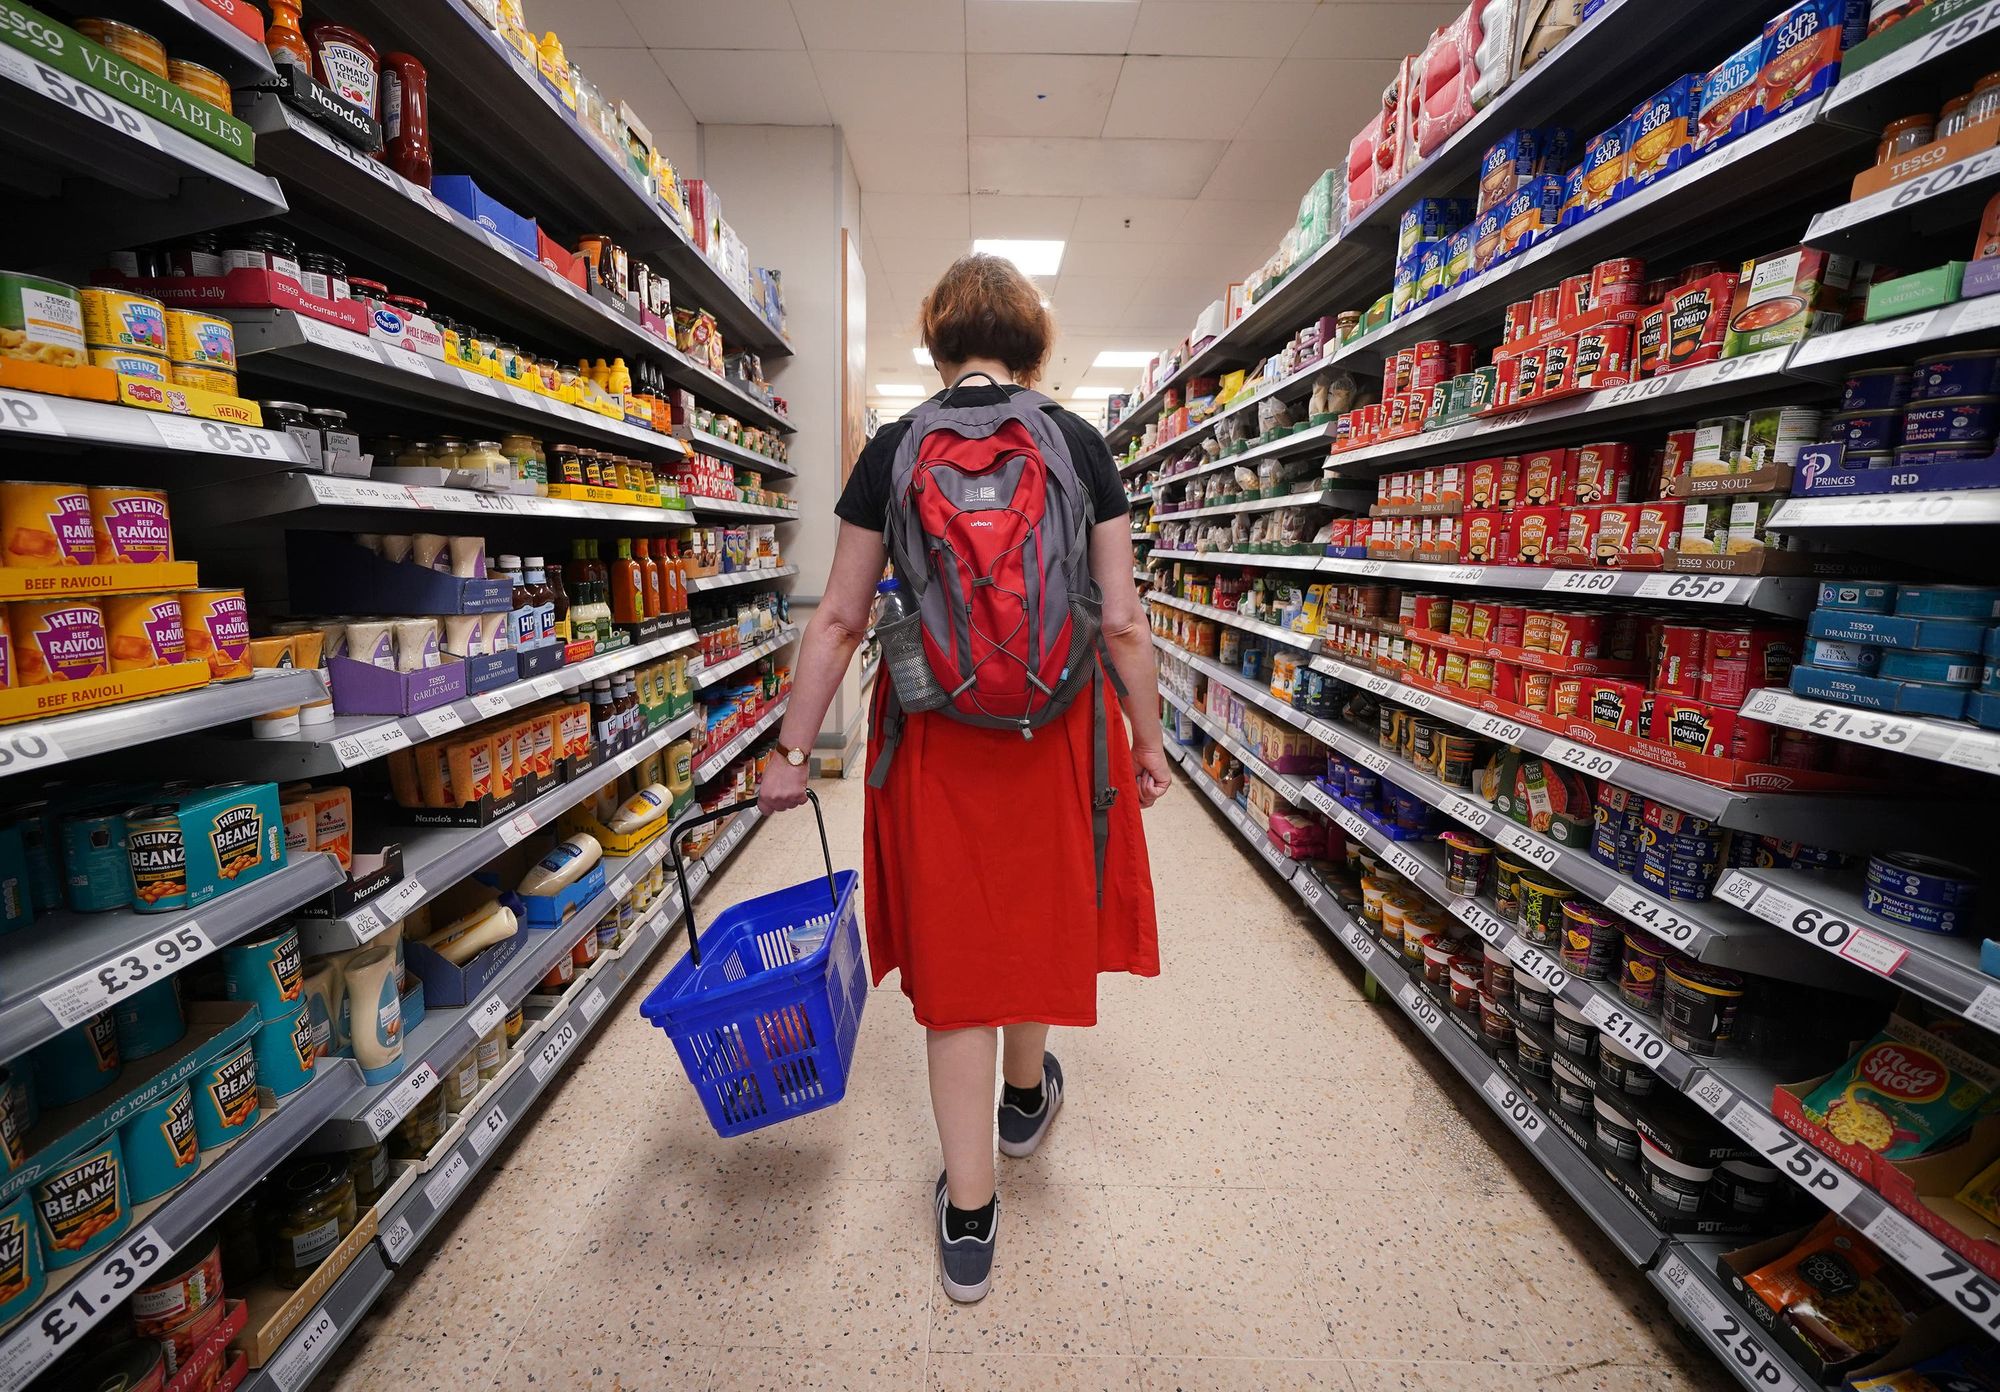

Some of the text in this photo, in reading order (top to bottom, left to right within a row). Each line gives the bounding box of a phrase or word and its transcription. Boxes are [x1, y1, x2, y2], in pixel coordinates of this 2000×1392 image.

[1776, 20, 1818, 54] SOUP
[334, 48, 367, 69] HEINZ
[333, 60, 370, 82] TOMATO
[337, 71, 369, 88] KETCHUP
[1713, 70, 1749, 100] SOUP
[33, 63, 142, 134] 50p
[79, 45, 243, 147] VEGETABLES
[310, 82, 371, 135] Nando's
[1642, 111, 1670, 135] SOUP
[1595, 143, 1621, 165] SOUP
[1891, 147, 1947, 175] TESCO
[1891, 155, 1995, 208] 60p
[1767, 258, 1788, 270] TESCO
[1755, 273, 1764, 286] 5
[200, 287, 226, 299] Jelly
[277, 282, 299, 296] TESCO
[1678, 292, 1706, 310] HEINZ
[133, 306, 161, 319] HEINZ
[340, 310, 356, 324] Jelly
[1673, 310, 1708, 329] TOMATO
[206, 326, 231, 339] HEINZ
[405, 325, 420, 339] WHOLE
[1887, 319, 1925, 338] 55p
[121, 361, 157, 374] HEINZ
[128, 384, 163, 402] Peppa Pig
[1609, 376, 1668, 405] £1.10
[217, 407, 250, 422] HEINZ
[1908, 410, 1945, 421] PRINCES
[1907, 423, 1919, 431] RED
[200, 422, 271, 455] 85p
[1905, 432, 1936, 441] SALMON
[1692, 477, 1752, 491] TESCO SOUP
[1815, 474, 1919, 486] PRINCES RED
[355, 488, 379, 497] £1.70
[119, 500, 164, 516] HEINZ
[117, 526, 168, 539] RAVIOLI
[1362, 562, 1381, 574] 65p
[1678, 558, 1735, 571] TESCO SOUP
[25, 575, 113, 590] BEEF RAVIOLI
[1564, 574, 1615, 590] £1.60
[1667, 575, 1726, 601] 65p
[50, 610, 100, 628] HEINZ
[521, 615, 536, 632] HP
[543, 611, 555, 628] HP
[1850, 622, 1874, 631] TESCO
[72, 631, 90, 639] BEEF
[1825, 629, 1897, 645] DRAINED TUNA
[50, 637, 105, 655] RAVIOLI
[1825, 648, 1848, 656] TUNA
[488, 660, 503, 669] TESCO
[1821, 653, 1851, 662] STEAKS
[428, 674, 446, 685] TESCO
[1367, 678, 1388, 691] 65p
[1832, 681, 1856, 692] TESCO
[37, 684, 124, 709] BEEF RAVIOLI
[413, 680, 460, 702] GARLIC SAUCE
[1403, 689, 1431, 706] £1.60
[1599, 692, 1620, 704] HEINZ
[1807, 686, 1881, 706] DRAINED TUNA
[489, 696, 505, 706] 95p
[440, 711, 456, 722] £1.35
[1594, 705, 1619, 719] TOMATO
[1678, 711, 1705, 726] HEINZ
[1481, 717, 1521, 741] £1.60
[1571, 727, 1594, 741] HEINZ
[1673, 726, 1706, 742] TOMATO
[1809, 707, 1907, 745] £1.35
[382, 729, 403, 742] £1.25
[1319, 729, 1338, 744] £1.35
[340, 745, 360, 757] 02D
[1629, 746, 1687, 769] FAVOURITE RECIPES
[1637, 741, 1677, 759] THE NATION'S
[575, 762, 592, 775] Nando's
[1364, 754, 1389, 772] £1.35
[1561, 748, 1613, 775] £2.80
[1528, 771, 1542, 780] WEST
[1751, 776, 1789, 789] HEINZ
[536, 780, 556, 794] Nando's
[492, 801, 516, 817] Nando's
[1313, 792, 1333, 811] £1.05
[219, 808, 252, 829] HEINZ
[415, 814, 452, 823] Nando's
[1452, 801, 1486, 827] £2.80
[216, 821, 259, 848] BEANZ
[1344, 816, 1367, 837] £1.05
[134, 832, 178, 847] HEINZ
[131, 847, 186, 867] BEANZ
[1511, 834, 1556, 864] £2.80
[1391, 852, 1420, 876] £1.10
[353, 874, 390, 902] Nando's
[400, 881, 418, 899] £2.10
[1302, 881, 1319, 900] 90p
[1728, 884, 1750, 899] 01C
[1883, 895, 1914, 911] PRINCES
[355, 913, 368, 923] 12L
[1461, 905, 1500, 938] £1.10
[1629, 900, 1692, 942] £4.20
[1882, 903, 1937, 923] TUNA CHUNKS
[357, 917, 377, 932] 02C
[1792, 909, 1850, 948] 60
[1350, 932, 1371, 955] 90p
[98, 927, 203, 995] £3.95
[481, 940, 518, 984] MAYONNAISE
[1519, 948, 1567, 988] £1.10
[486, 1000, 501, 1016] 95p
[1411, 996, 1438, 1025] 90p
[1603, 1011, 1664, 1060] £1.10
[543, 1026, 572, 1065] £2.20
[411, 1069, 431, 1089] 95p
[1553, 1051, 1597, 1091] #YOUCANMAKEIT
[1865, 1056, 1925, 1094] Shot
[111, 1058, 198, 1122] OF YOUR 5 A DAY
[1700, 1085, 1721, 1103] 01B
[373, 1108, 386, 1118] 12L
[375, 1109, 393, 1128] 02B
[1502, 1090, 1539, 1131] 90p
[486, 1109, 503, 1133] £1
[445, 1157, 462, 1179] £1.40
[1765, 1130, 1839, 1191] 75p
[50, 1159, 107, 1194] HEINZ
[45, 1169, 115, 1218] BEANZ
[390, 1226, 408, 1247] 02A
[311, 1219, 375, 1296] GHERKINS
[1667, 1267, 1686, 1285] 01A
[41, 1235, 159, 1345] £1.35
[303, 1318, 330, 1352] £1.10
[1712, 1314, 1782, 1386] 25p
